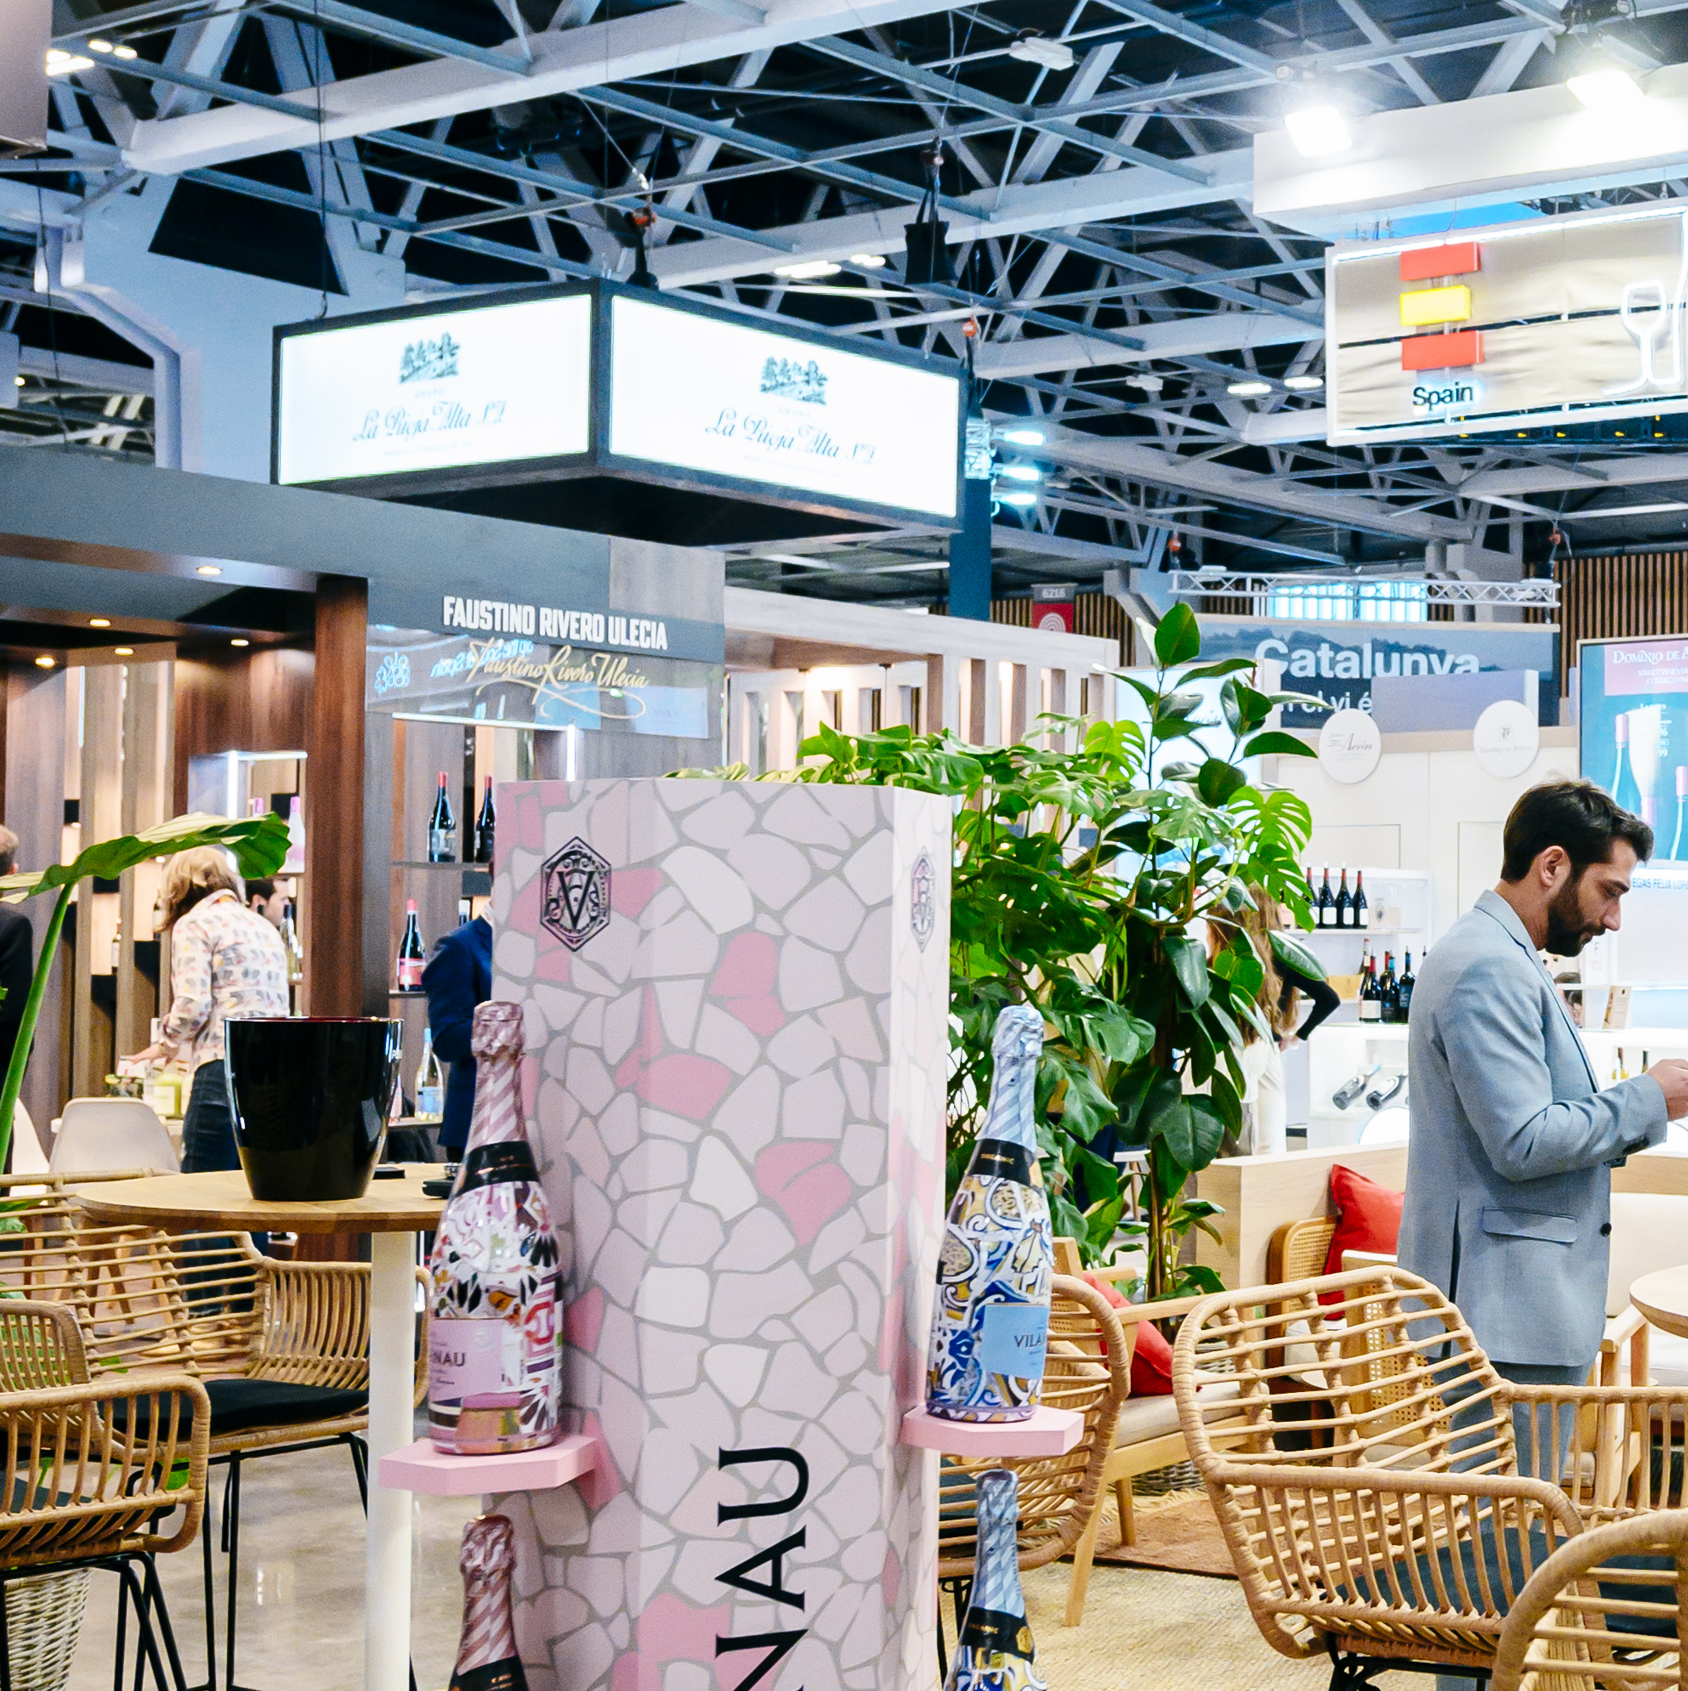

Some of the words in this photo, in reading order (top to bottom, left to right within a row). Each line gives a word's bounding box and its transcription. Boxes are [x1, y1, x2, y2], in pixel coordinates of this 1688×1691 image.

[1412, 381, 1475, 412] Spain
[353, 409, 380, 442] La
[705, 407, 737, 437] La
[443, 595, 536, 635] FAUSTINO
[539, 606, 605, 643] RIVERO
[608, 616, 668, 650] ULECIA
